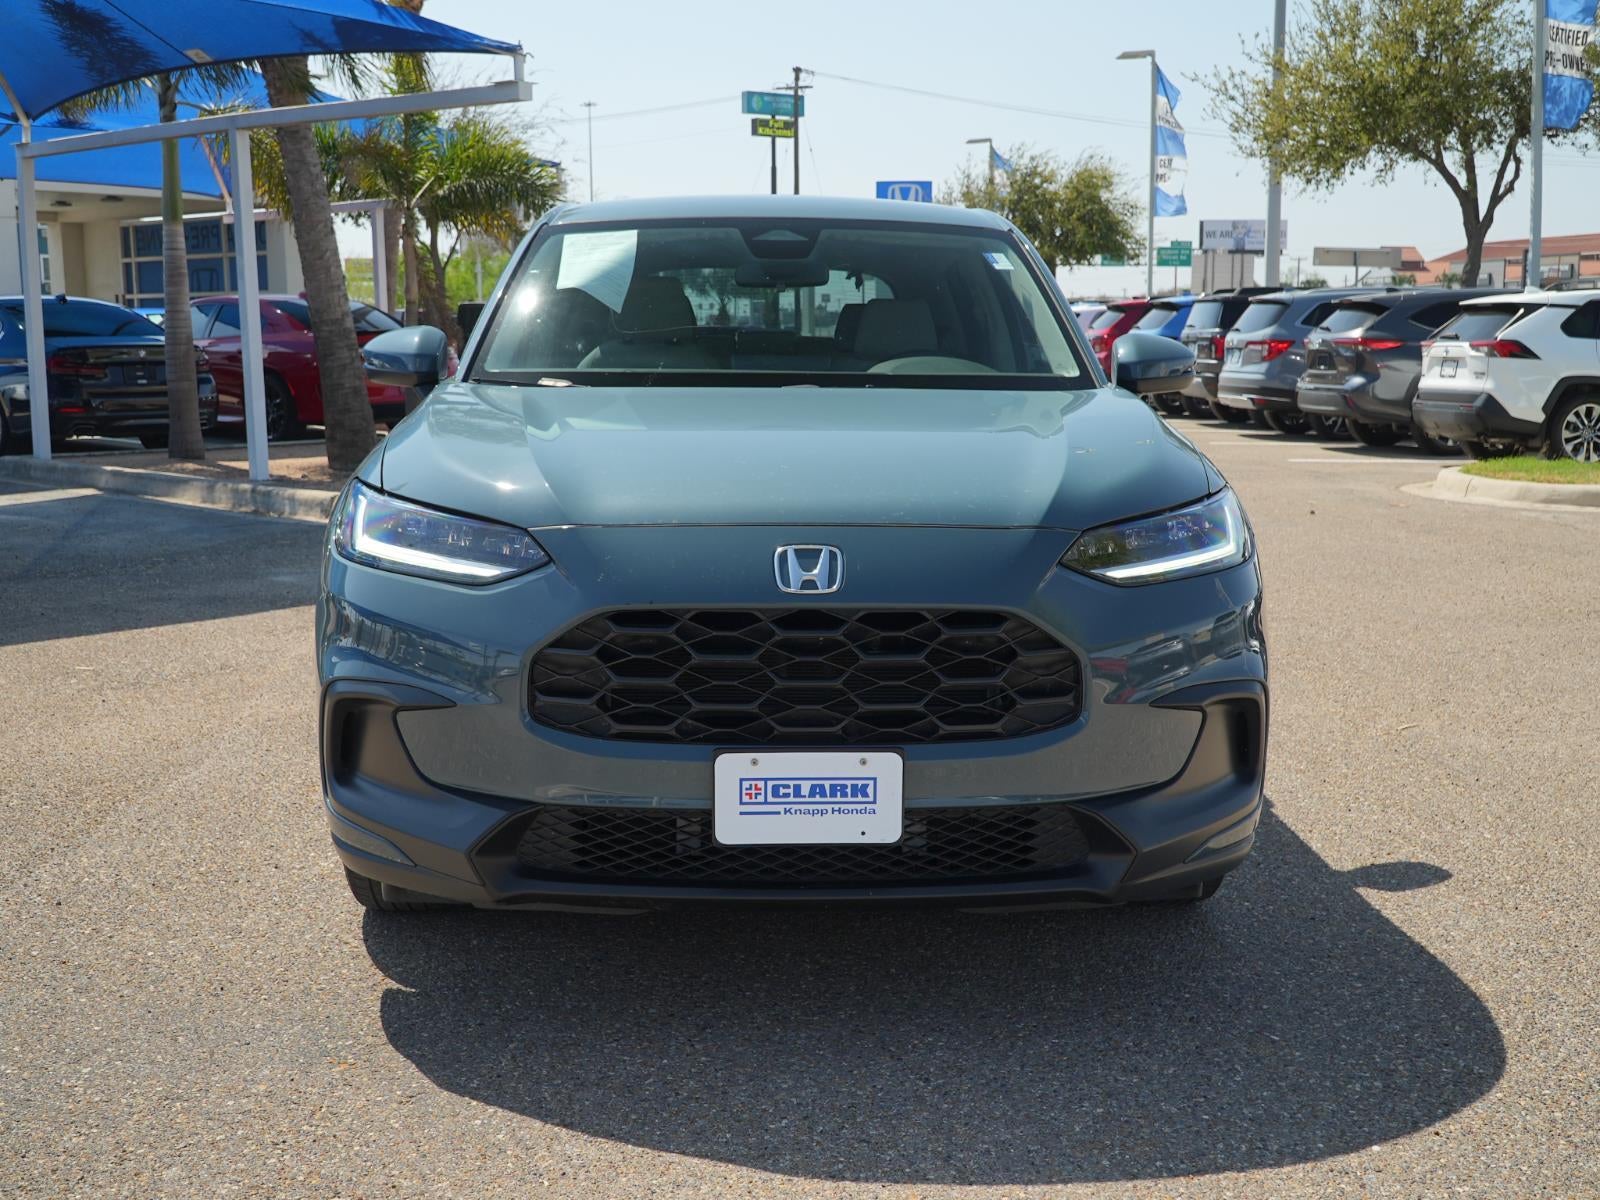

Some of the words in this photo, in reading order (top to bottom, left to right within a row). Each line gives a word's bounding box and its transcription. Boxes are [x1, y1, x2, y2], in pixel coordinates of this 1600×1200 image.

[1549, 24, 1588, 46] CERTIFIED
[1205, 230, 1216, 239] WE
[771, 783, 870, 798] CLARK
[783, 807, 828, 816] Knapp
[831, 806, 876, 815] Honda
